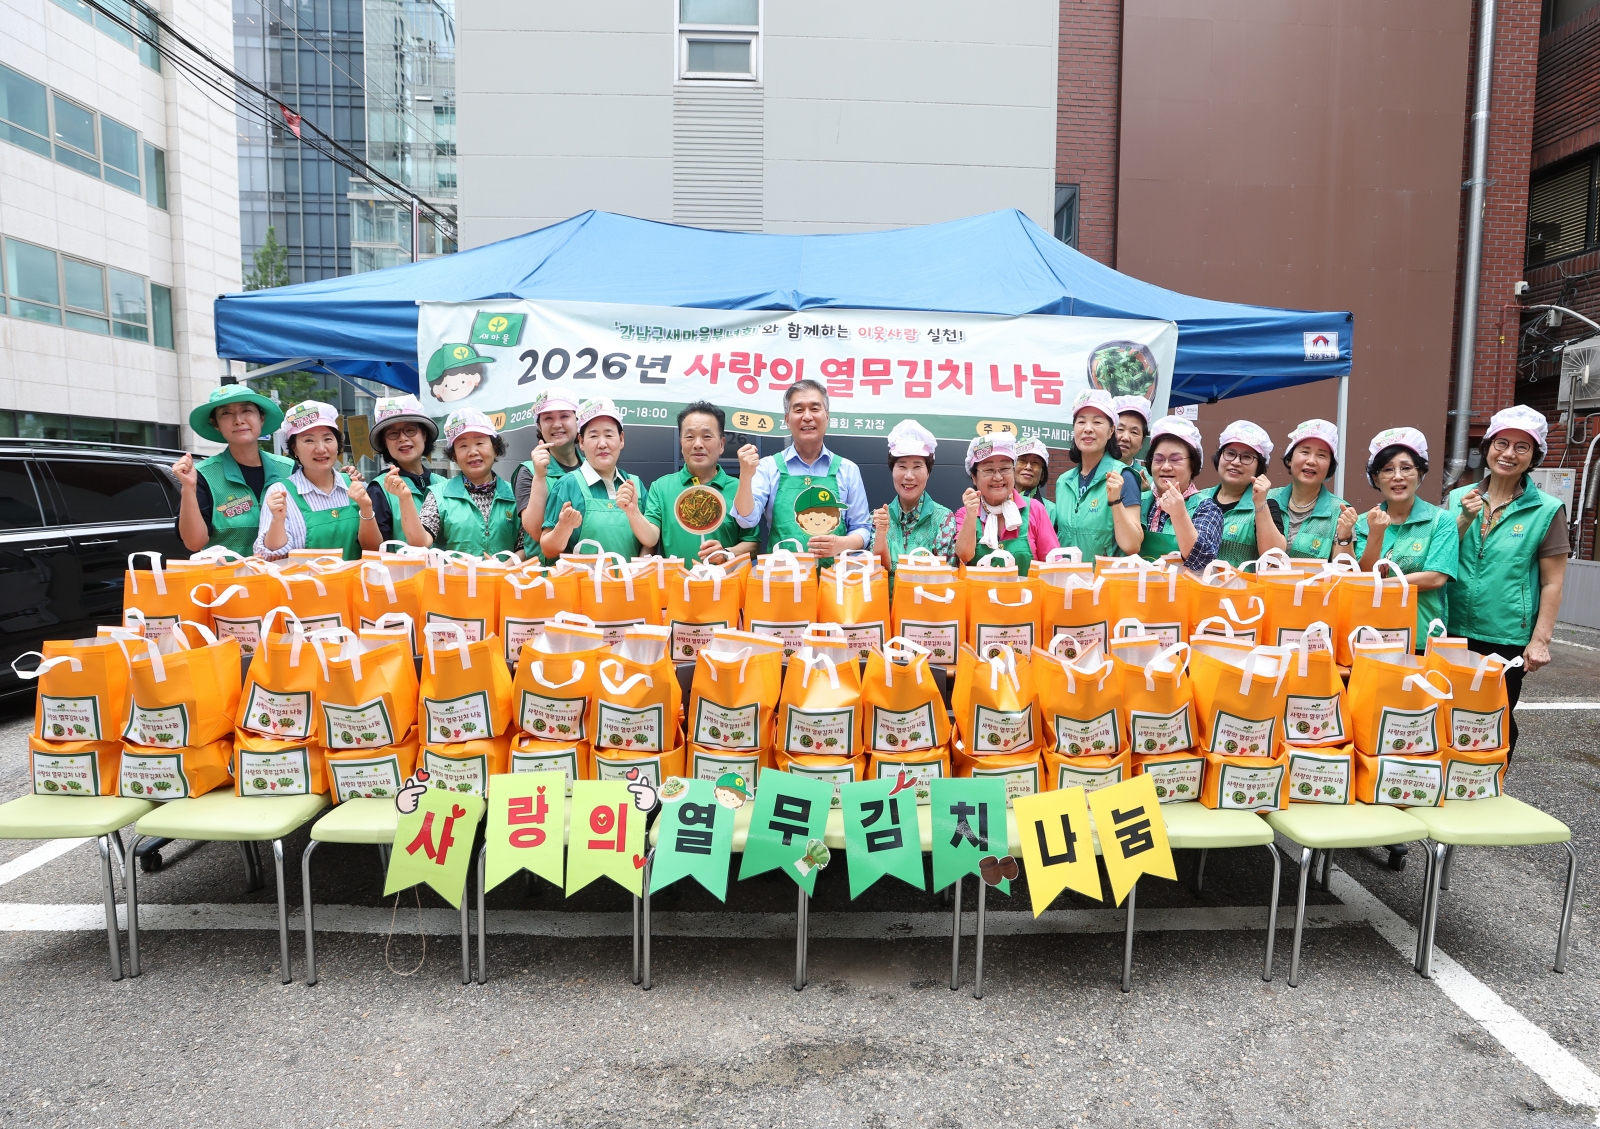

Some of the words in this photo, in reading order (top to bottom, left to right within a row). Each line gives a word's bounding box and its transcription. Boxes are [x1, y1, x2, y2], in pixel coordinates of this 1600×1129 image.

[788, 322, 849, 339] 함께하는
[858, 326, 918, 341] 이웃사랑
[927, 328, 963, 342] 실천!
[517, 347, 672, 386] 2026년
[683, 352, 805, 395] 사랑의
[820, 357, 973, 399] 열무김치
[990, 363, 1064, 405] 나눔
[854, 418, 885, 430] 주차장
[1290, 711, 1308, 719] 사랑의
[1220, 728, 1237, 738] 사랑의
[1387, 728, 1405, 737] 사랑의
[1294, 772, 1311, 780] 사랑의
[340, 780, 355, 788] 사랑의
[1227, 780, 1245, 789] 사랑의
[1385, 777, 1401, 785] 사랑의
